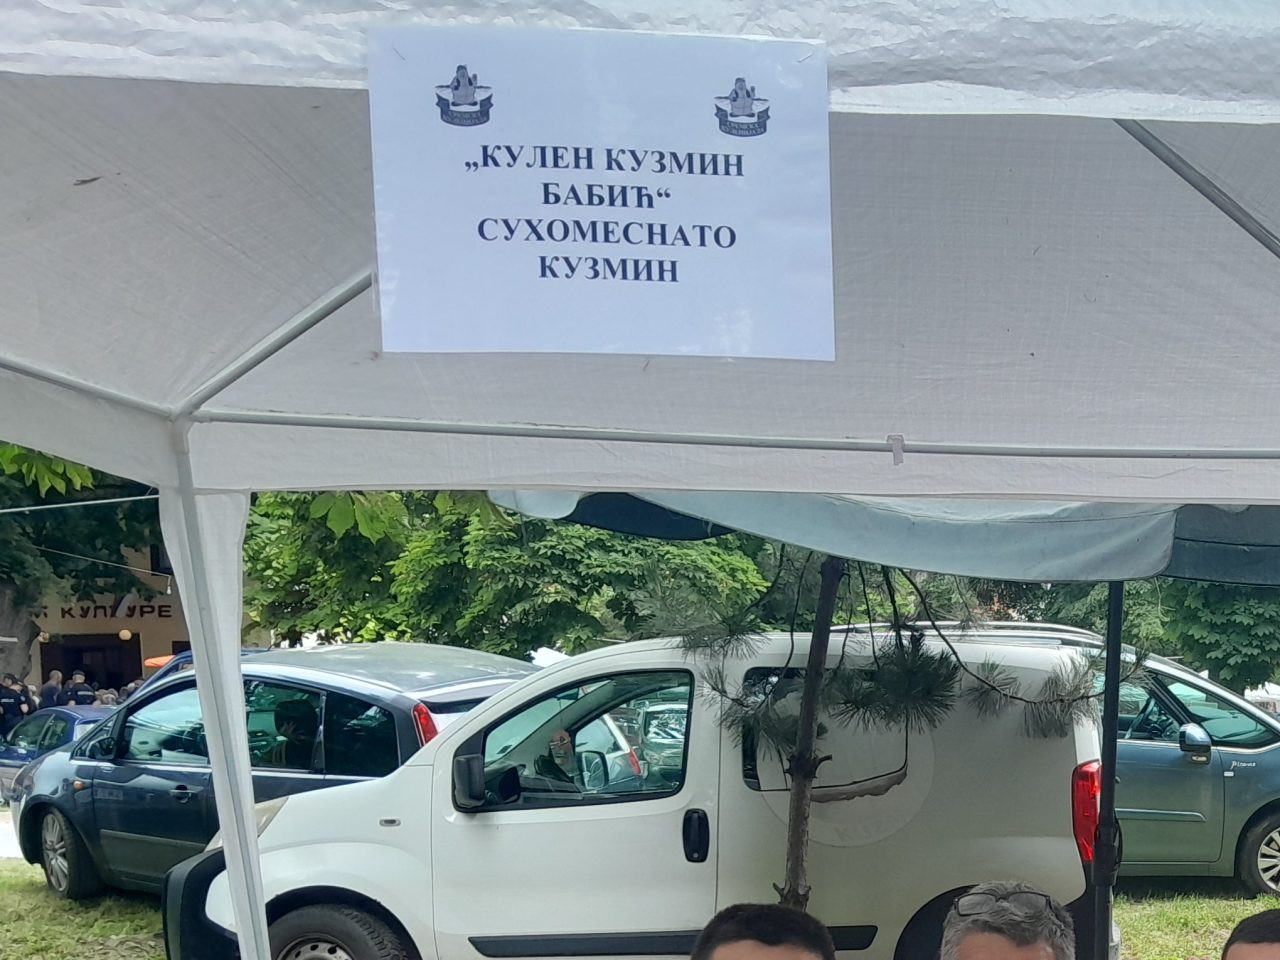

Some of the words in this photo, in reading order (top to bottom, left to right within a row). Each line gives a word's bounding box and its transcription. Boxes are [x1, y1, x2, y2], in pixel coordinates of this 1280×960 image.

[464, 144, 594, 172] „КУЛЕН
[605, 148, 745, 177] КУЗМИН
[541, 182, 671, 209] БАБИЋ“
[477, 217, 737, 249] СУХОМЕСНАТО
[538, 255, 679, 283] КУЗМИН
